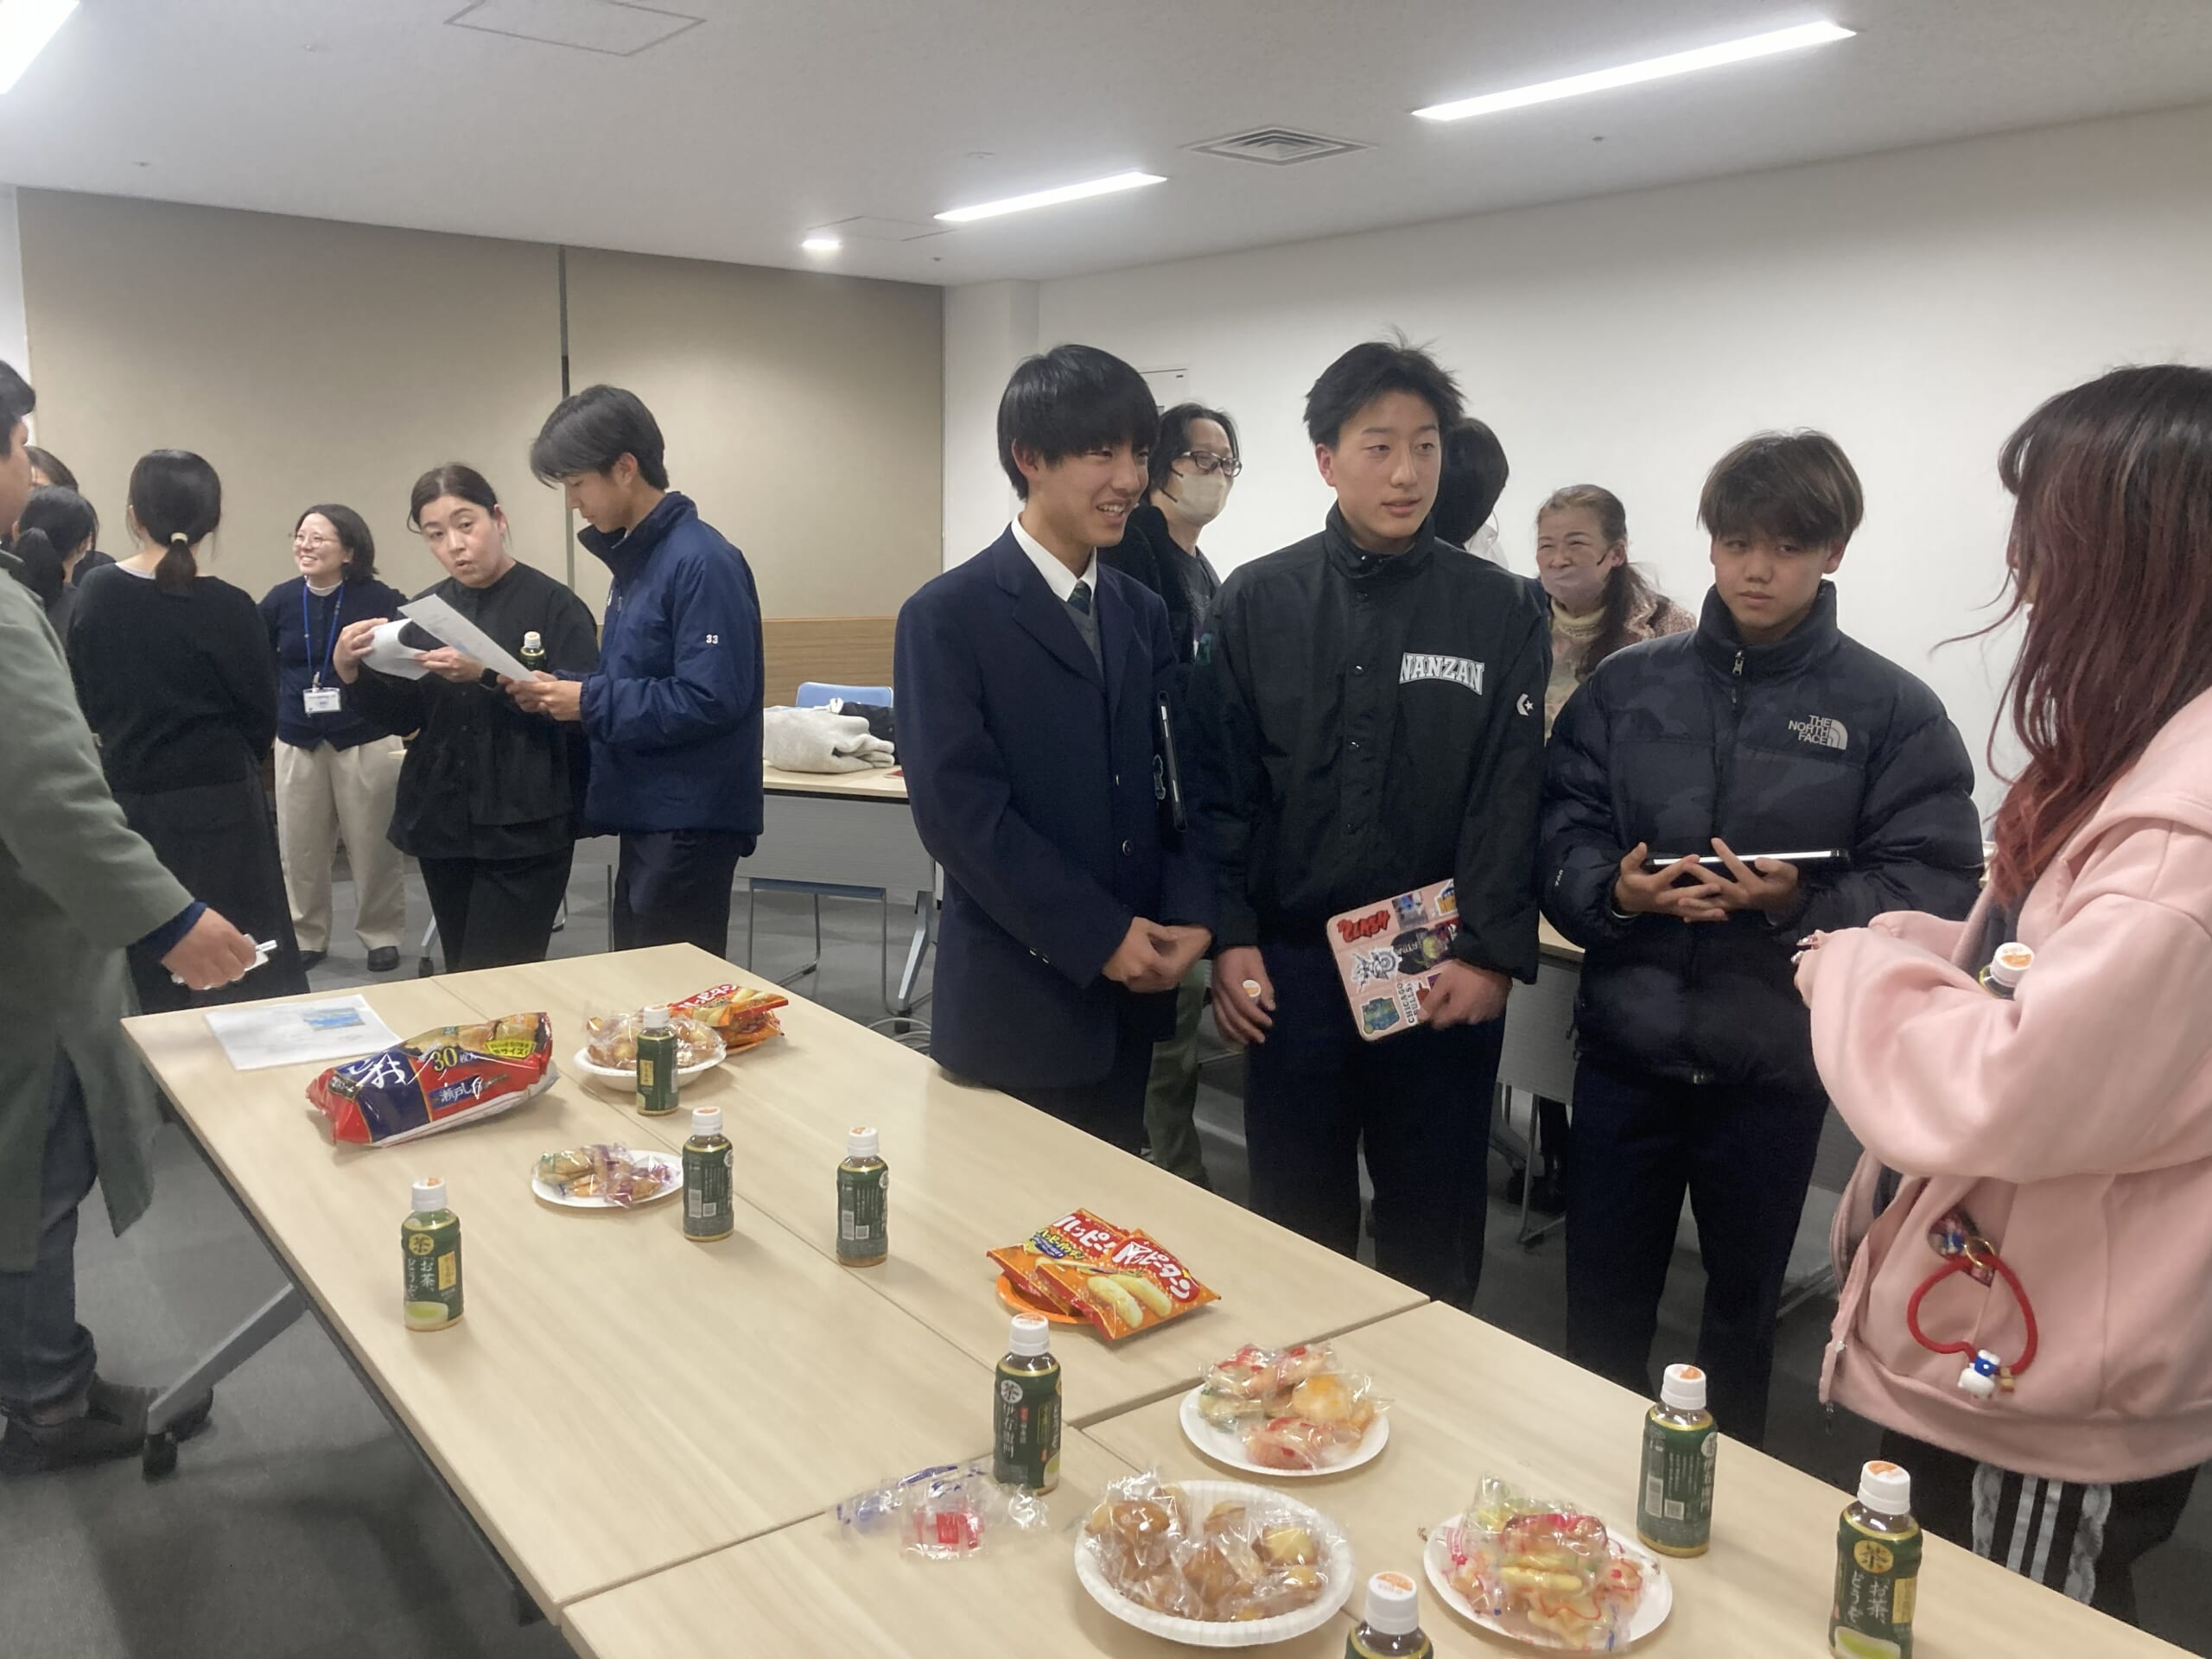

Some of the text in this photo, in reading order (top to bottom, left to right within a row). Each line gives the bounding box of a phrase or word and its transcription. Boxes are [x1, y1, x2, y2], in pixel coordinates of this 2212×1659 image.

[1399, 652, 1485, 696] NANZAN
[1788, 720, 1830, 739] NORTH
[1808, 715, 1832, 728] THE
[1798, 731, 1827, 746] FACE
[1396, 982, 1415, 1024] CHICAGO
[434, 1046, 458, 1071] 30
[1112, 1242, 1190, 1299] ハッピーターン
